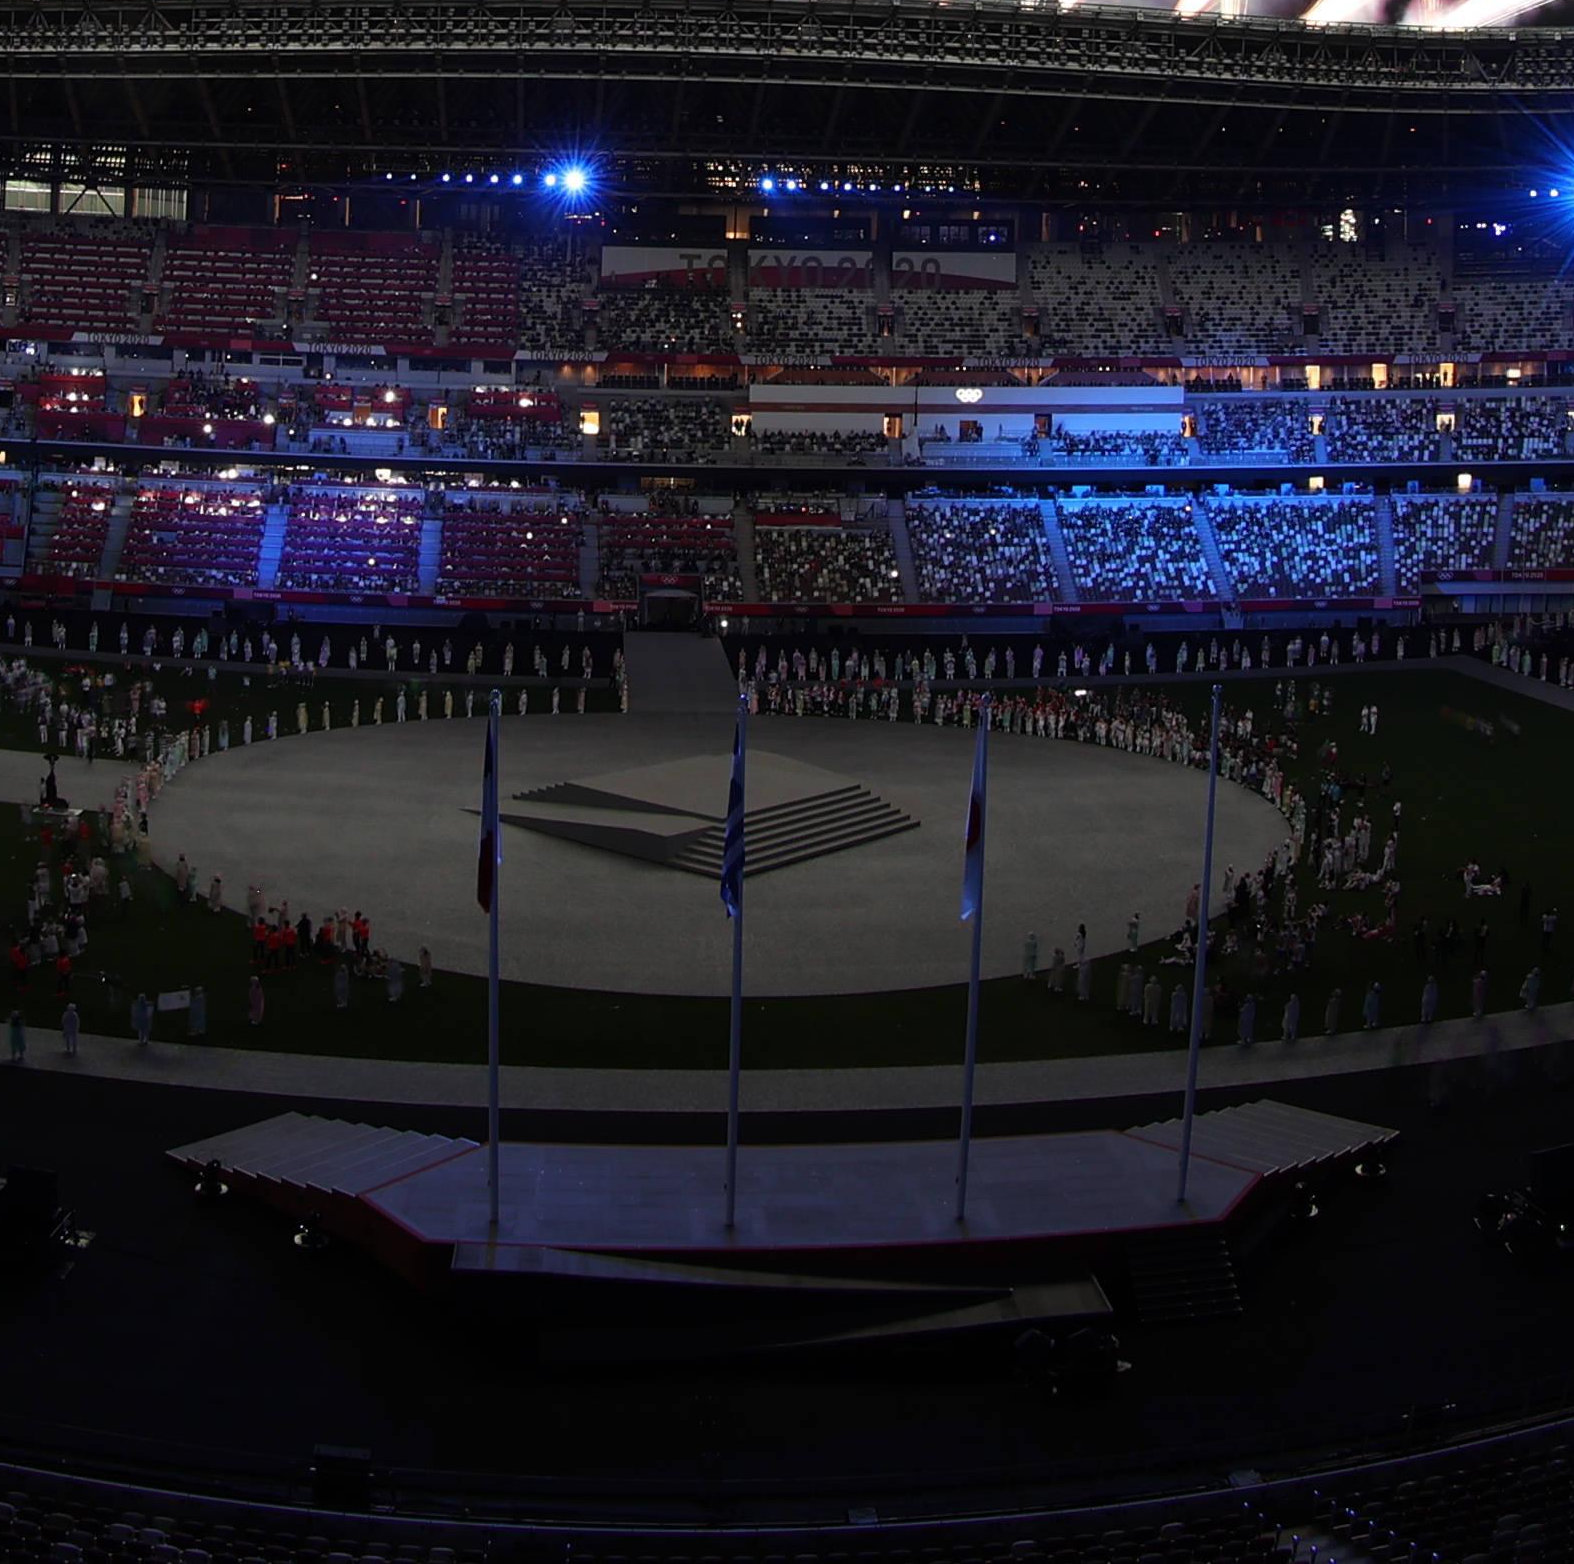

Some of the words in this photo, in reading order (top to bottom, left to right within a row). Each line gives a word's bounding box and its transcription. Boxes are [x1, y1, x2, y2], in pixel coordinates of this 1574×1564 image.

[680, 254, 824, 287] TOKYO
[89, 332, 121, 344] TOKYO
[122, 333, 149, 345] 2020
[310, 343, 342, 354] TOKYO
[343, 343, 371, 355] 2020
[531, 350, 564, 361] TOKYO
[565, 351, 593, 361] 2020
[755, 355, 788, 365] TOKYO
[789, 355, 817, 365] 2020
[1409, 354, 1440, 363] TOKYO
[1442, 354, 1468, 363] 2020
[978, 357, 1010, 367] TOKYO
[1012, 357, 1039, 367] 2020
[1195, 357, 1227, 367] TOKYO
[1228, 357, 1255, 367] 2020
